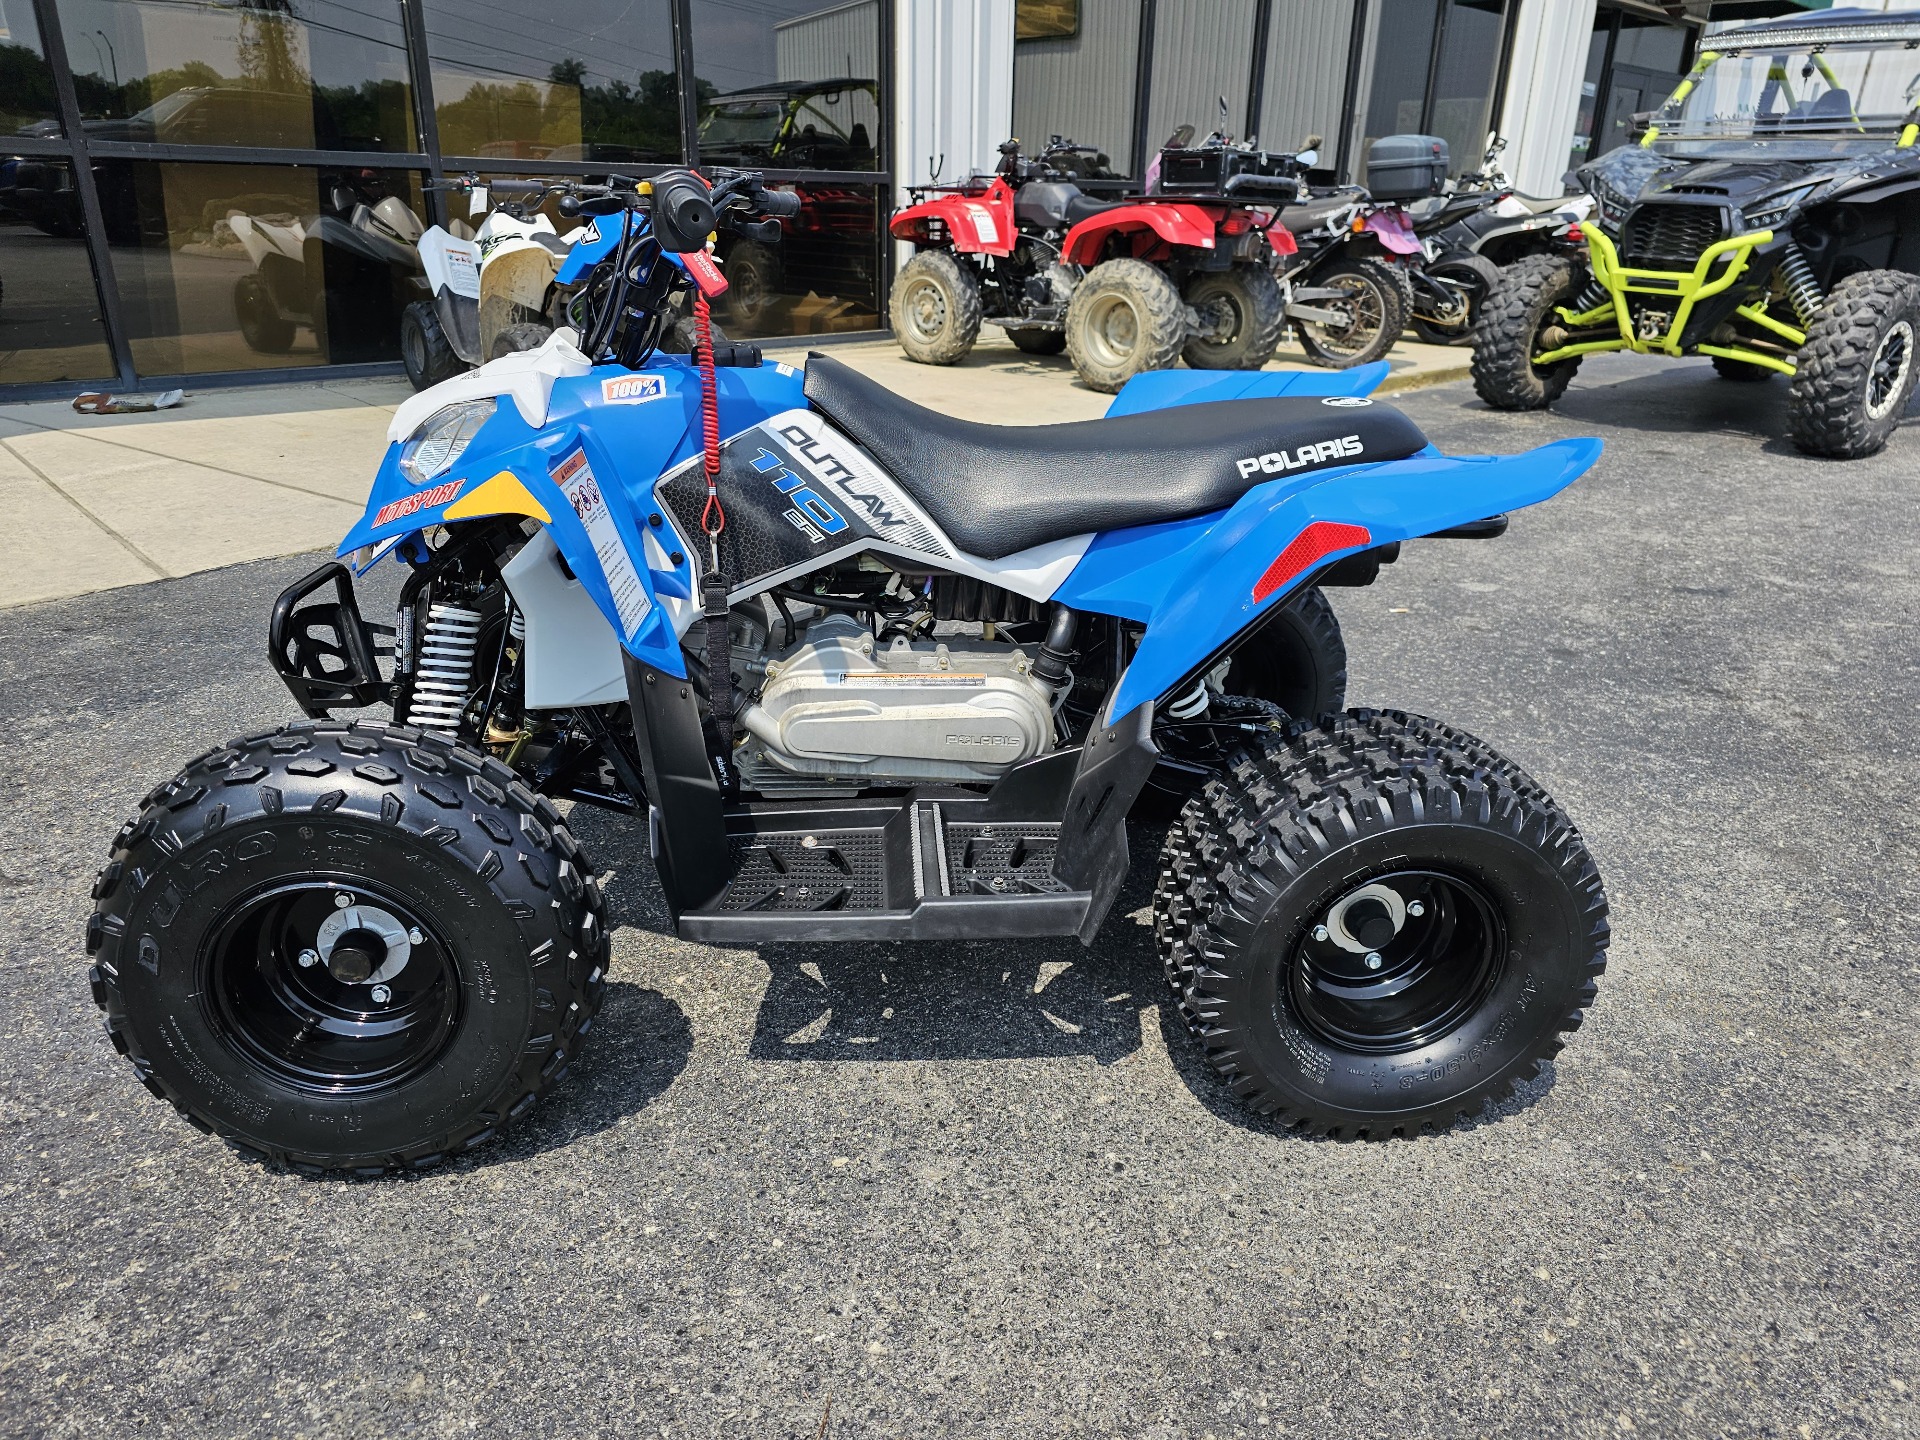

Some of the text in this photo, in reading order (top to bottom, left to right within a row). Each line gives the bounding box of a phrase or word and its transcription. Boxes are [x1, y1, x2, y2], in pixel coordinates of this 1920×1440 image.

[611, 380, 656, 399] 100%
[777, 426, 908, 526] OUTLAW
[1236, 435, 1363, 479] POLARIS
[371, 478, 467, 529] MOTOSPORT
[750, 447, 849, 535] 110
[782, 508, 826, 543] EFI
[946, 735, 1020, 746] POLARIS
[138, 830, 278, 975] DURO
